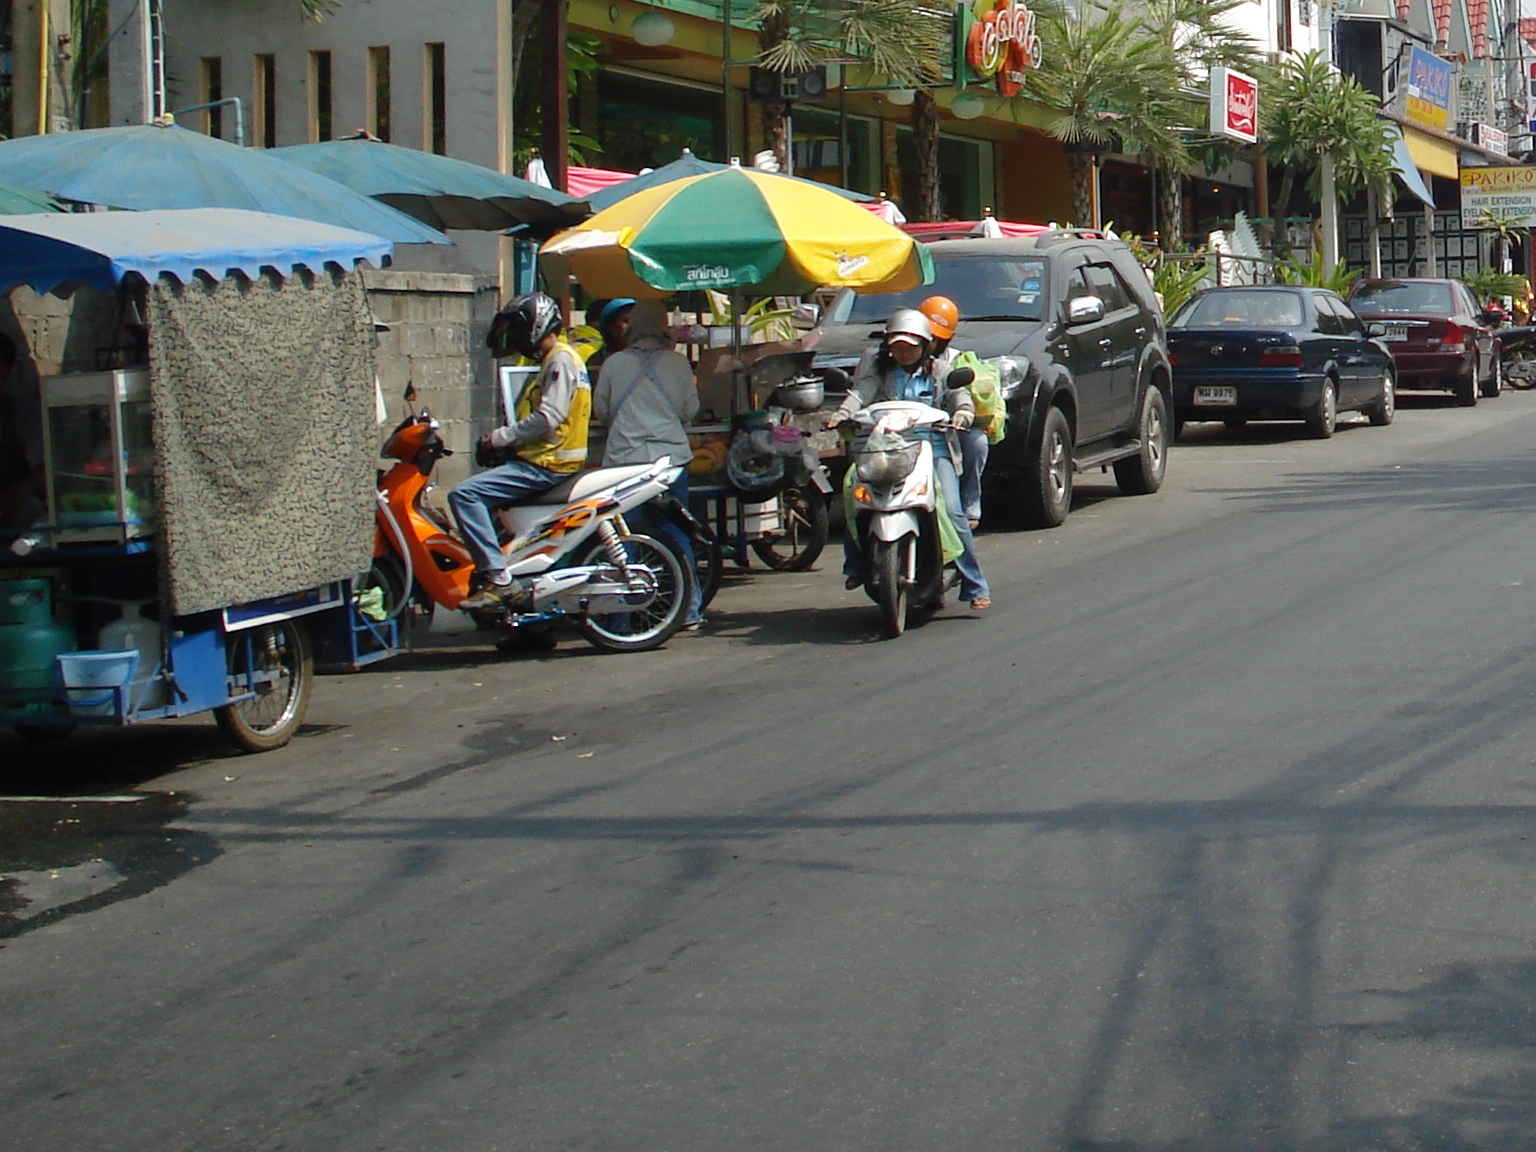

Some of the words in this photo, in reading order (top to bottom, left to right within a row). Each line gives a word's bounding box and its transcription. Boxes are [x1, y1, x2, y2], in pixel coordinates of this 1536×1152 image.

[1470, 169, 1533, 185] PAKIKO
[1471, 197, 1489, 205] HAIR
[1491, 196, 1532, 205] EXTENSION
